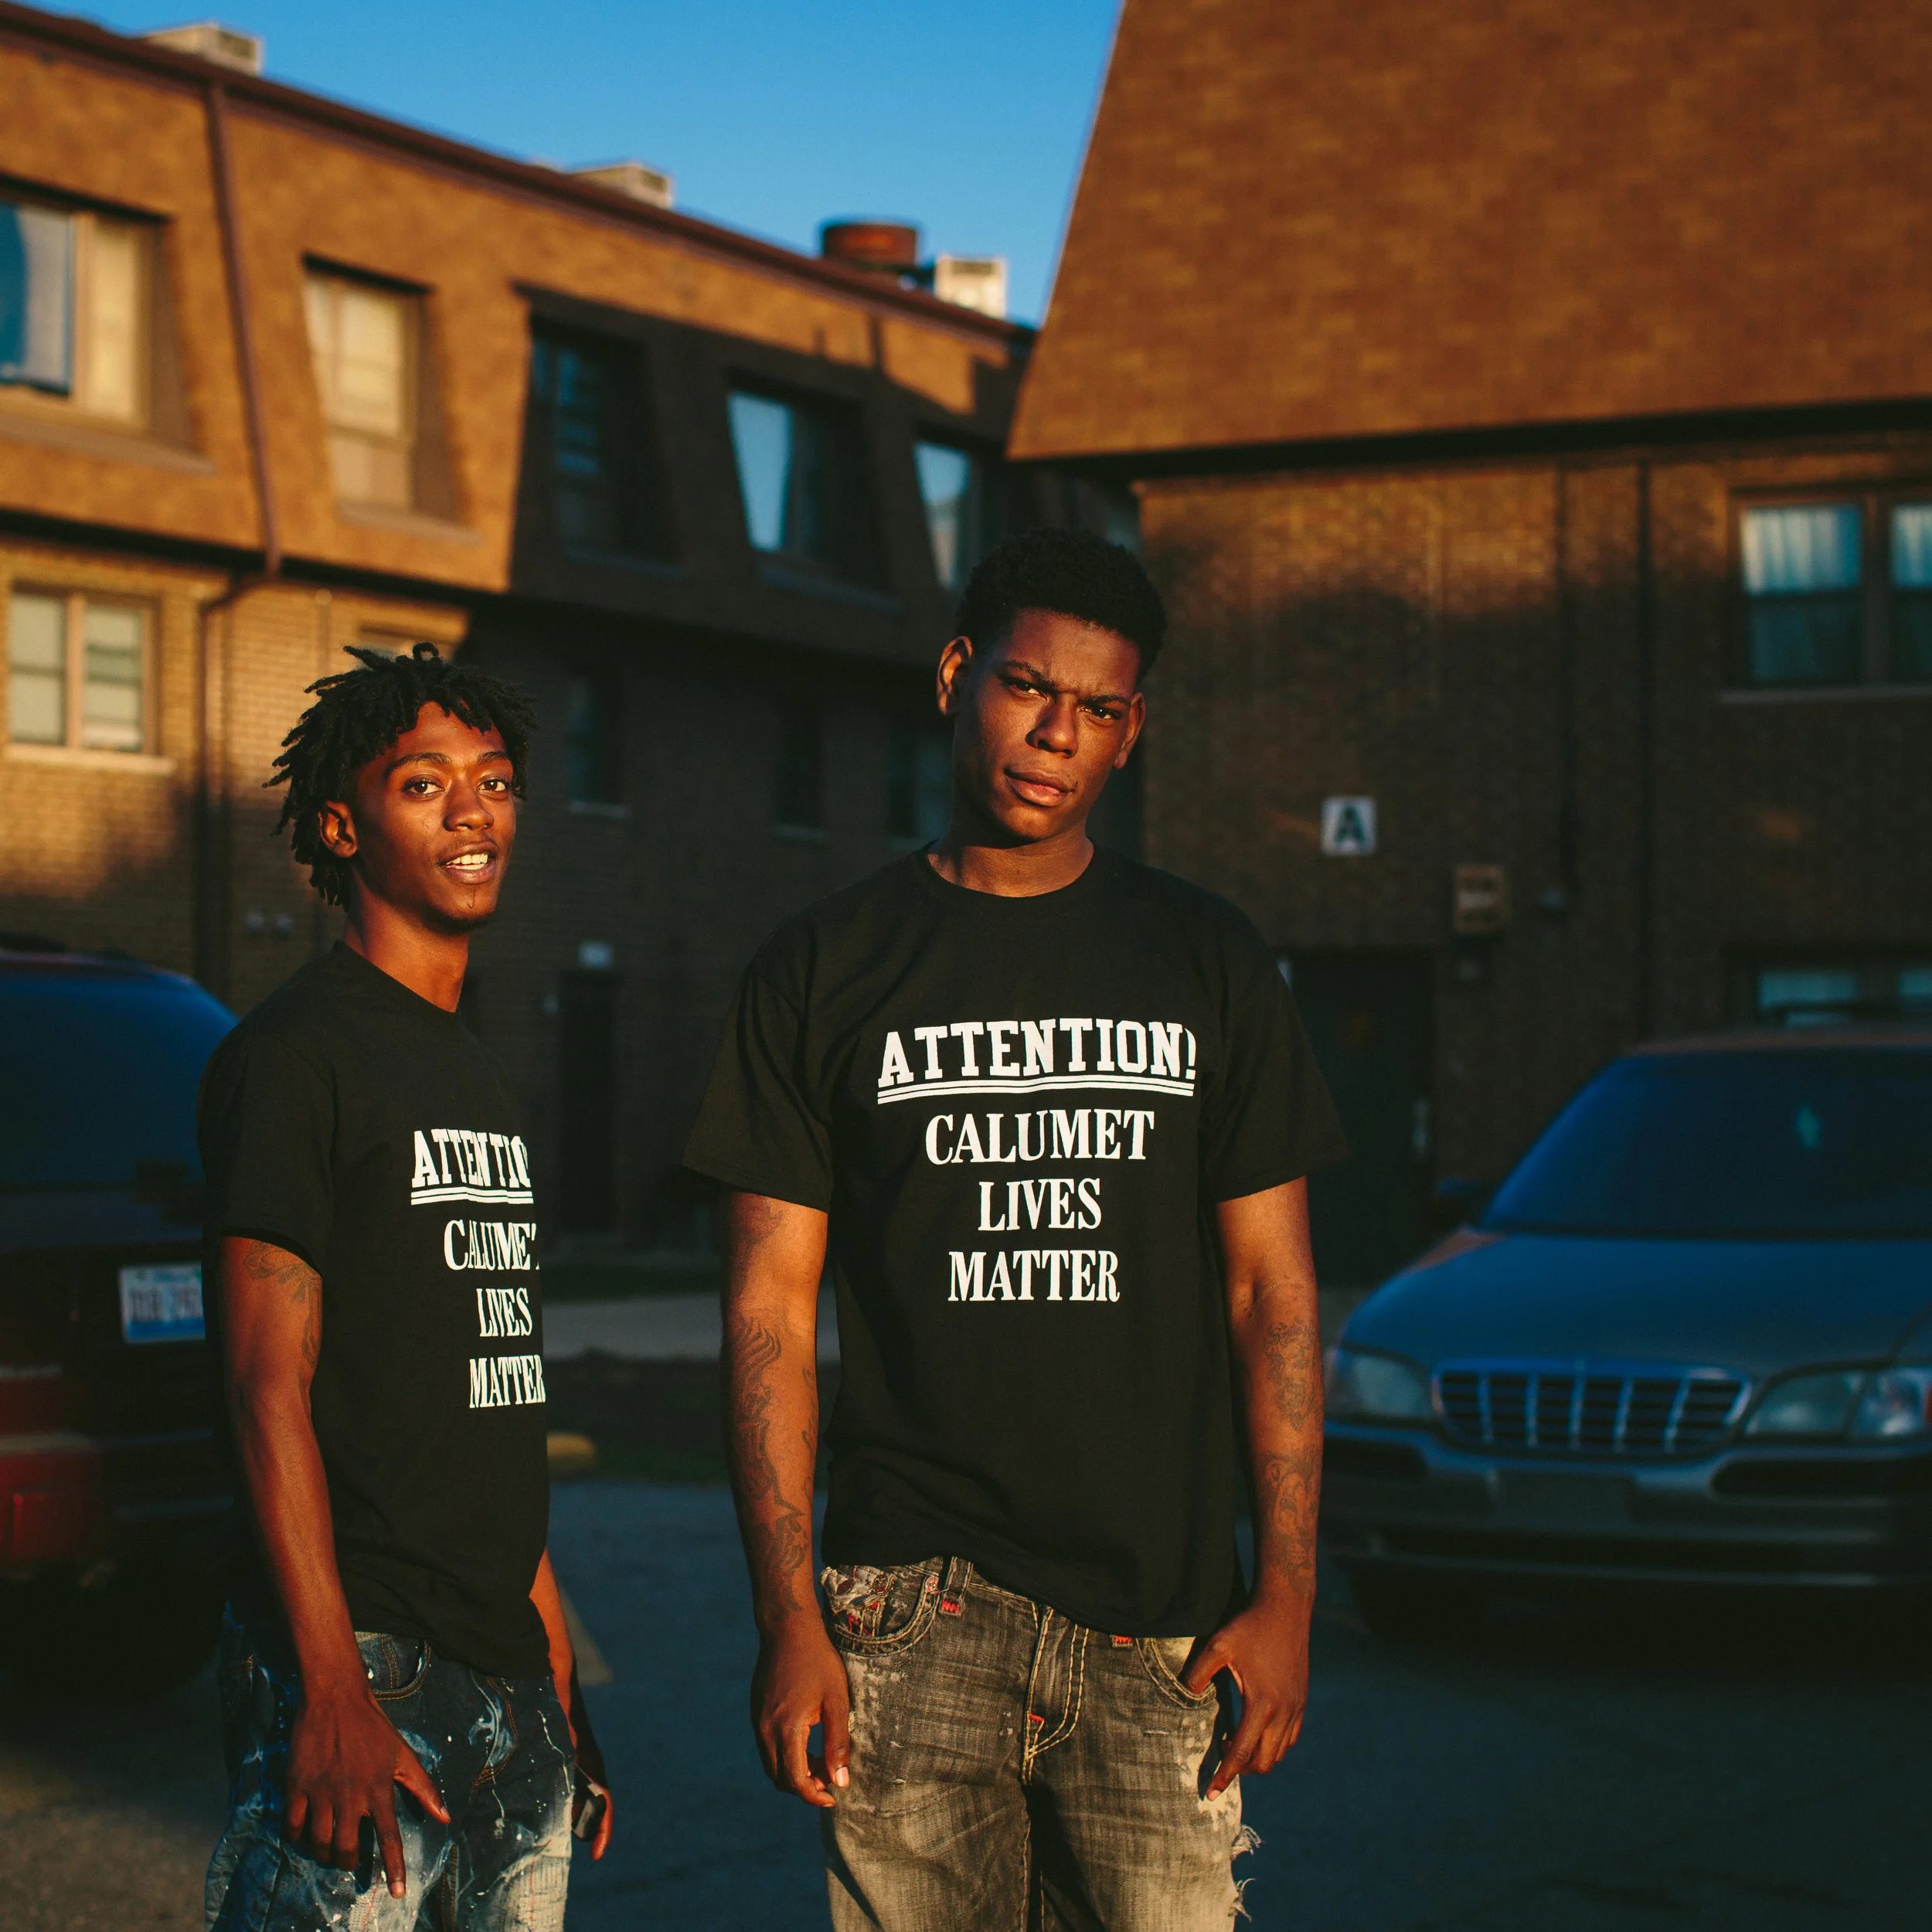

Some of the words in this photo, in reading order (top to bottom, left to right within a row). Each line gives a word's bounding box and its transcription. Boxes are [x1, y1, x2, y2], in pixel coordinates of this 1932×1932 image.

[1335, 804, 1367, 846] A
[878, 1018, 1196, 1088] ATTENTION!
[925, 1108, 1155, 1165] CALUMET
[978, 1178, 1102, 1231] LIVES
[947, 1250, 1121, 1303] MATTER
[475, 1287, 533, 1338] LIVES
[469, 1354, 546, 1409] MATTER
